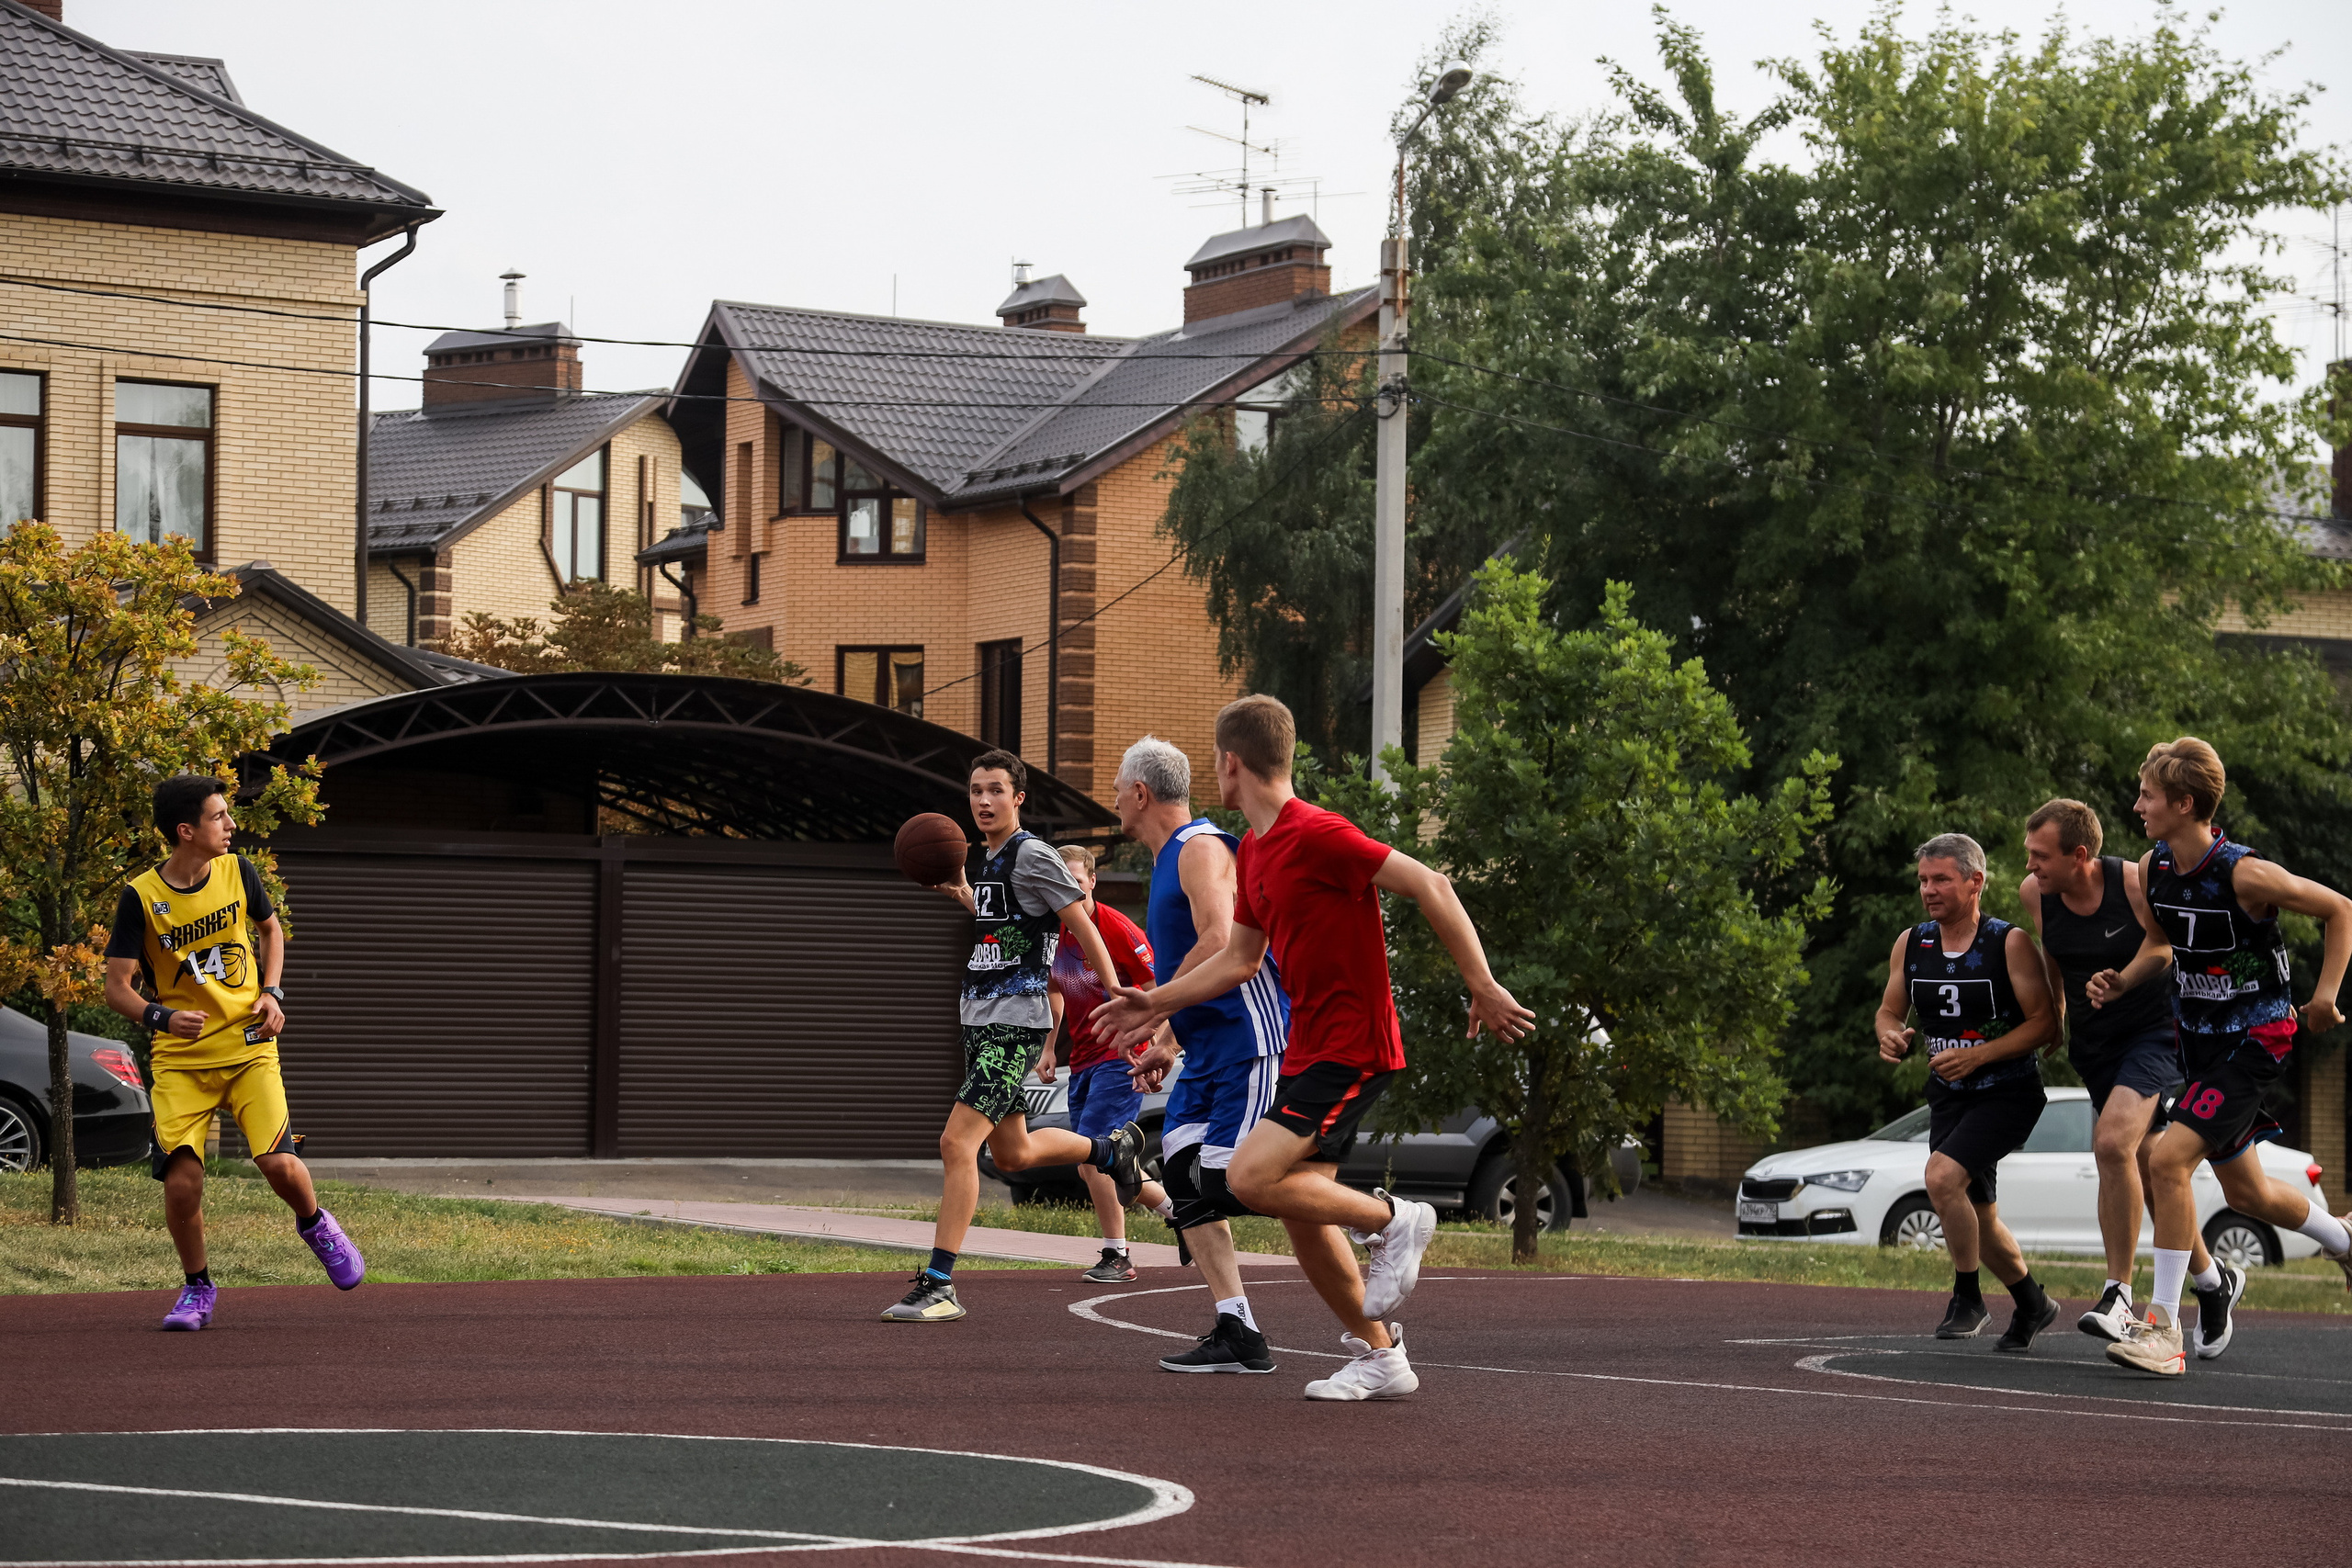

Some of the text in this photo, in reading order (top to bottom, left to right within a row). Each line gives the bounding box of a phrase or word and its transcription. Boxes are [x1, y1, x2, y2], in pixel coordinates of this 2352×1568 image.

[973, 886, 994, 917] 42
[171, 900, 240, 953] BASKET
[2177, 911, 2196, 947] 7
[187, 945, 227, 985] 14
[1938, 984, 1962, 1017] 3
[2178, 1081, 2224, 1120] 18
